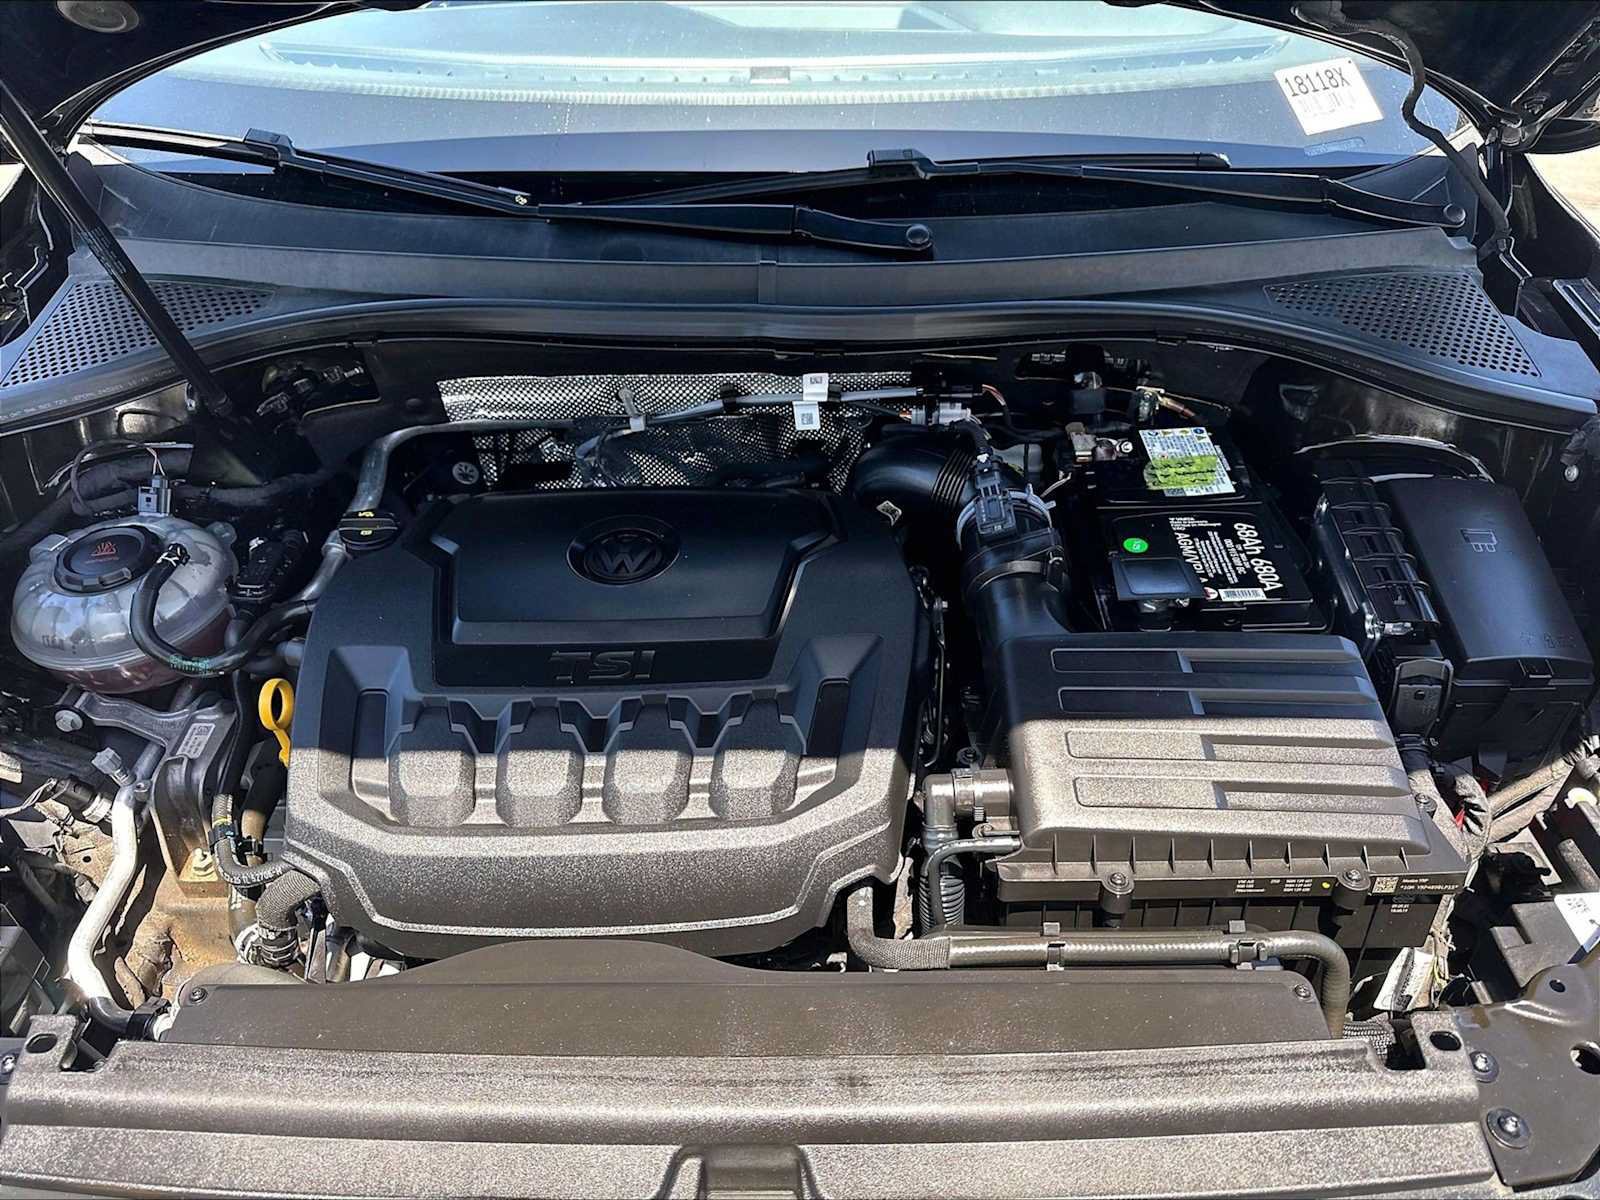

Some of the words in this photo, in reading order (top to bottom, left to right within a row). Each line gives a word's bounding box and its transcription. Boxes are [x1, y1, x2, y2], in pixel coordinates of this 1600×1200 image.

[1284, 66, 1351, 97] 18118X
[1233, 522, 1266, 555] 68Ah
[1250, 557, 1284, 592] 680A
[550, 649, 656, 680] TSI
